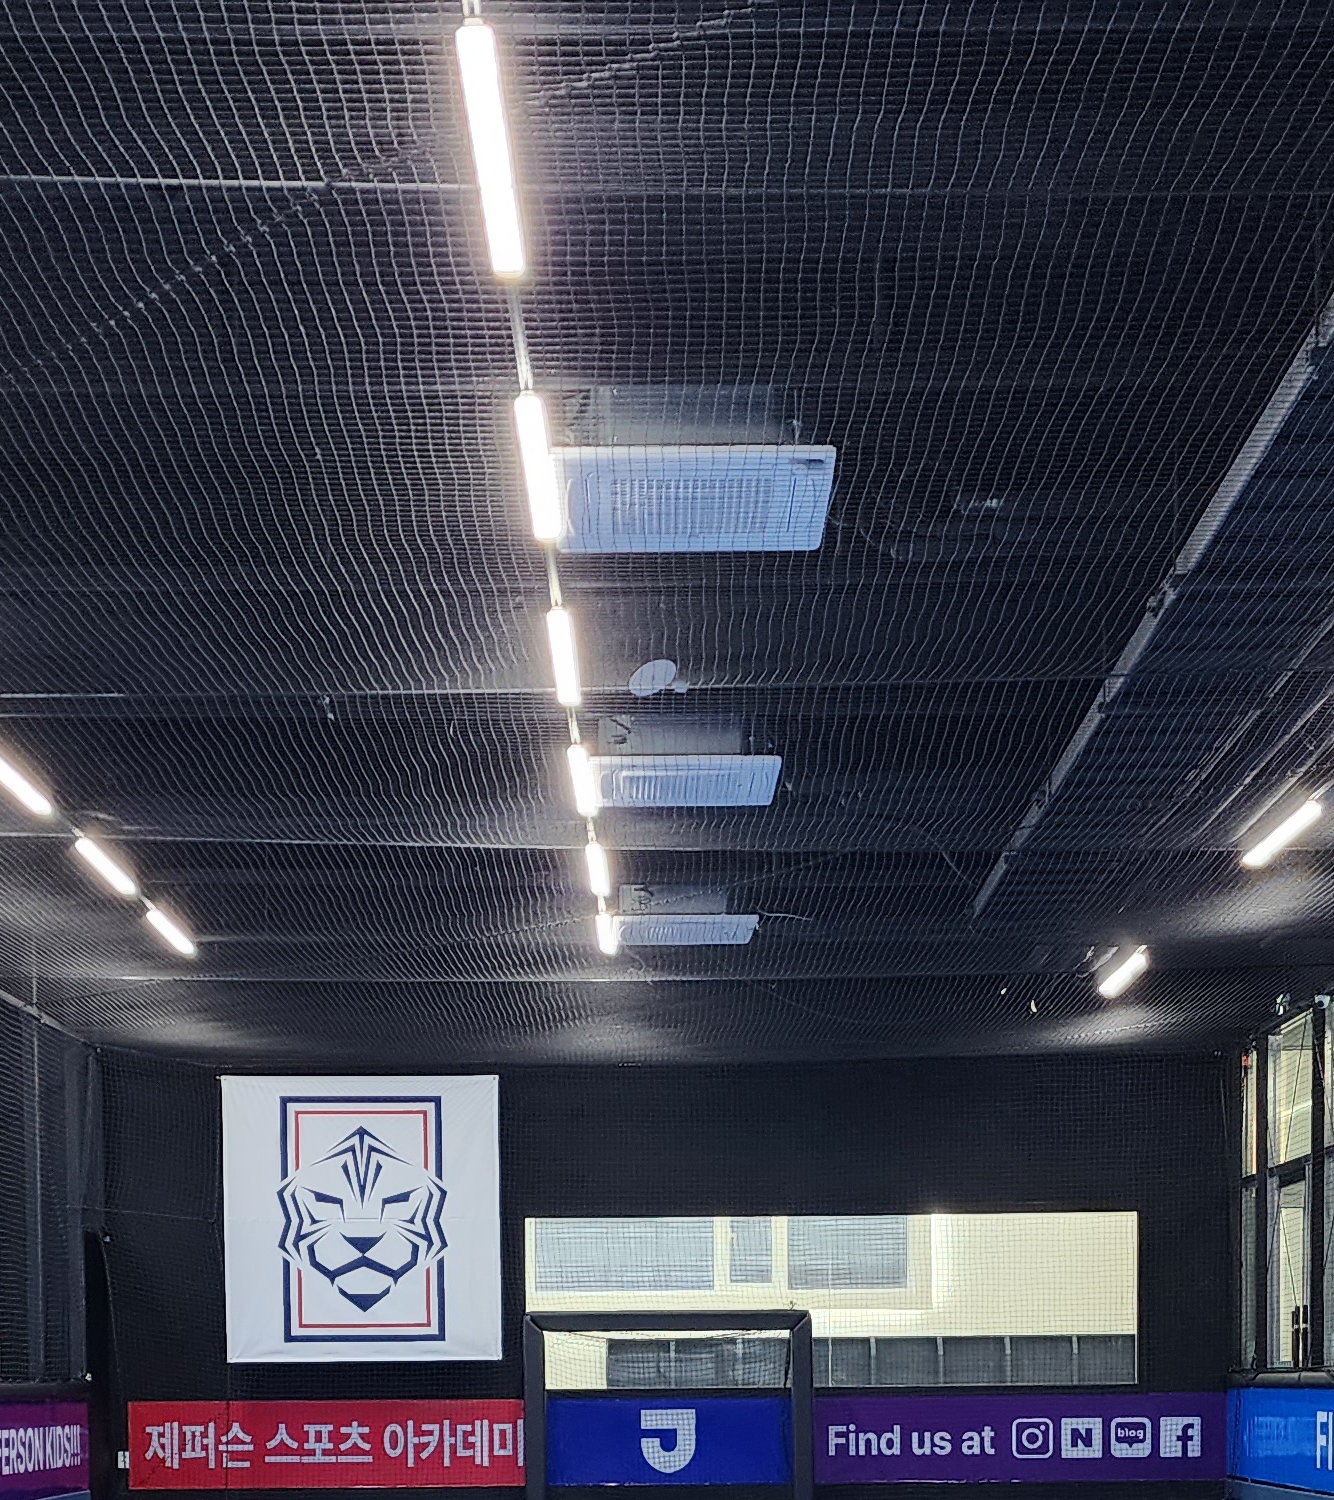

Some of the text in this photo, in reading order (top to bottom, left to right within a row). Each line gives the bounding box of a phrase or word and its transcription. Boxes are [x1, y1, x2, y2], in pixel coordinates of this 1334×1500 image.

[45, 1424, 81, 1471] KIDS!!!
[144, 1418, 525, 1469] 제퍼슨 스포츠 아카데미
[827, 1424, 901, 1456] Find
[911, 1431, 952, 1456] us
[961, 1426, 995, 1456] at
[1117, 1427, 1144, 1440] blog
